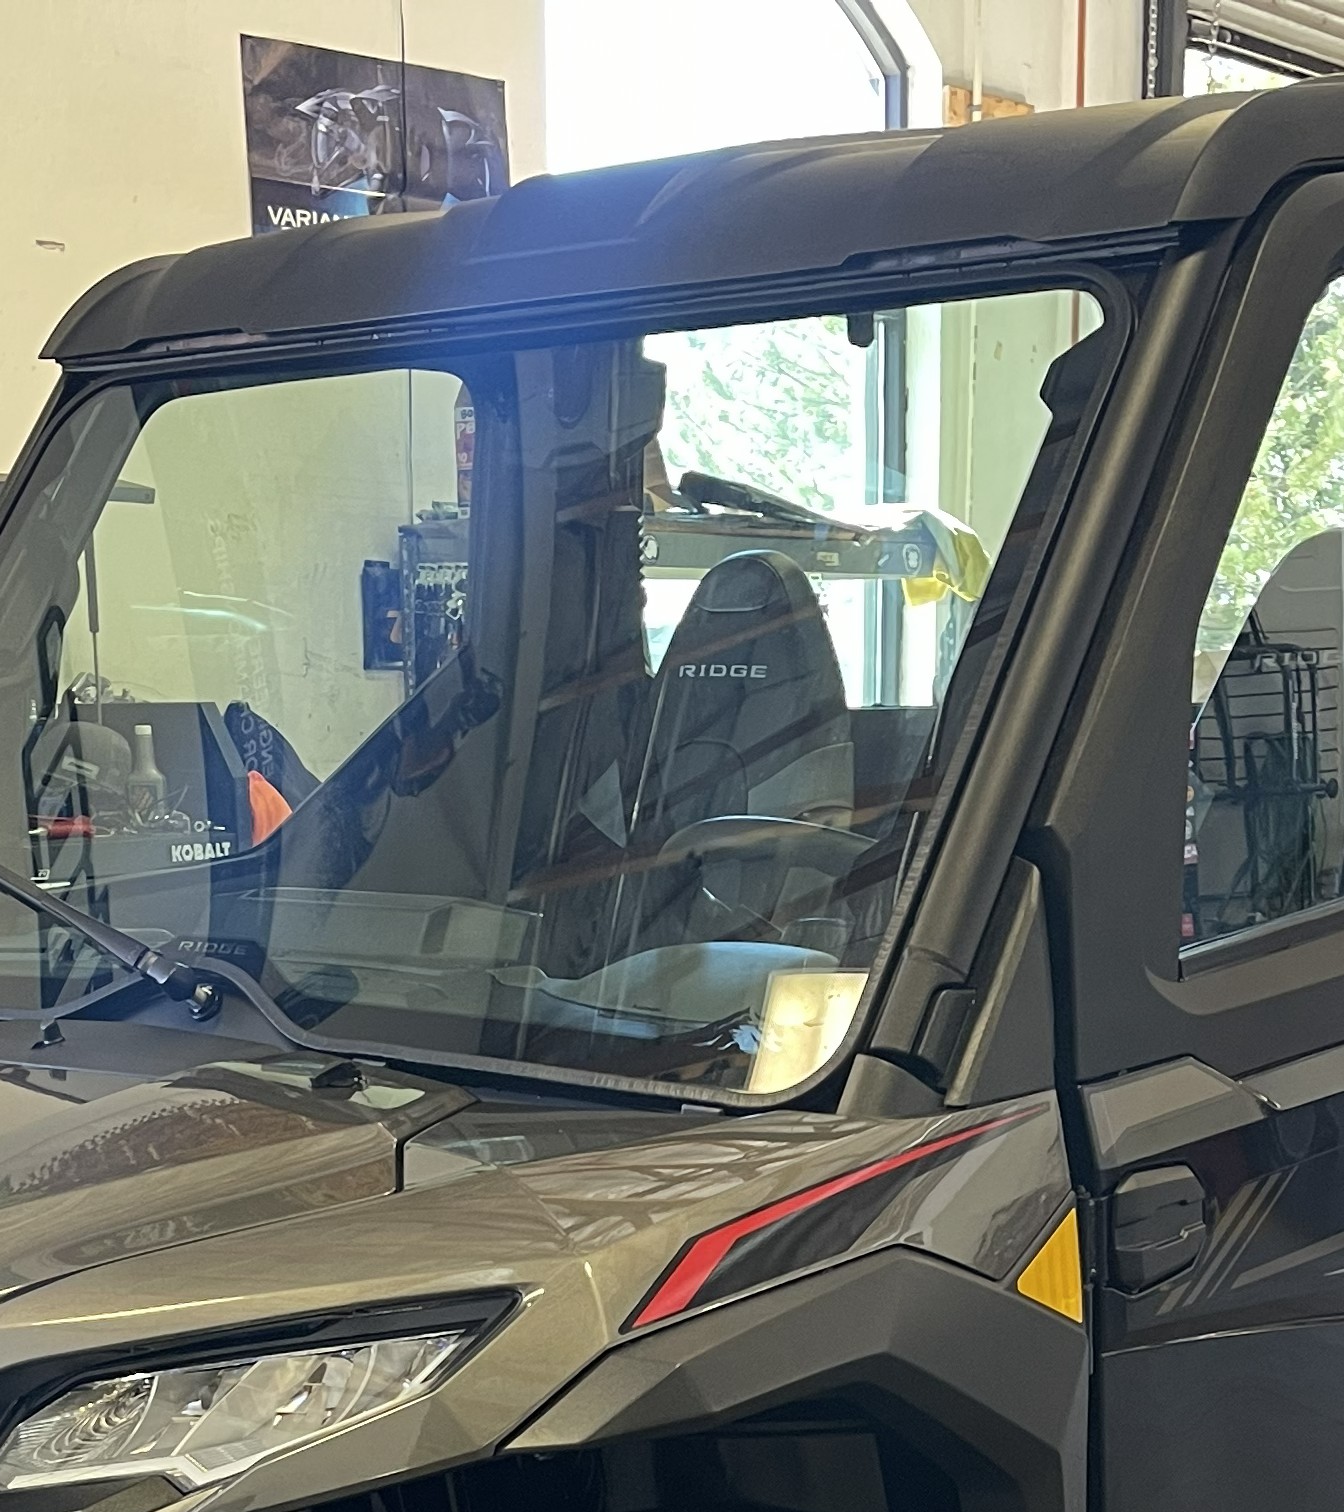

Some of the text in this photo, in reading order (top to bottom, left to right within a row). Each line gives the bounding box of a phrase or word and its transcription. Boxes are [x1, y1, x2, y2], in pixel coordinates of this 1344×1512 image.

[679, 664, 768, 679] RIDGE
[171, 841, 231, 863] KOBALT
[178, 940, 248, 956] RIDGE
